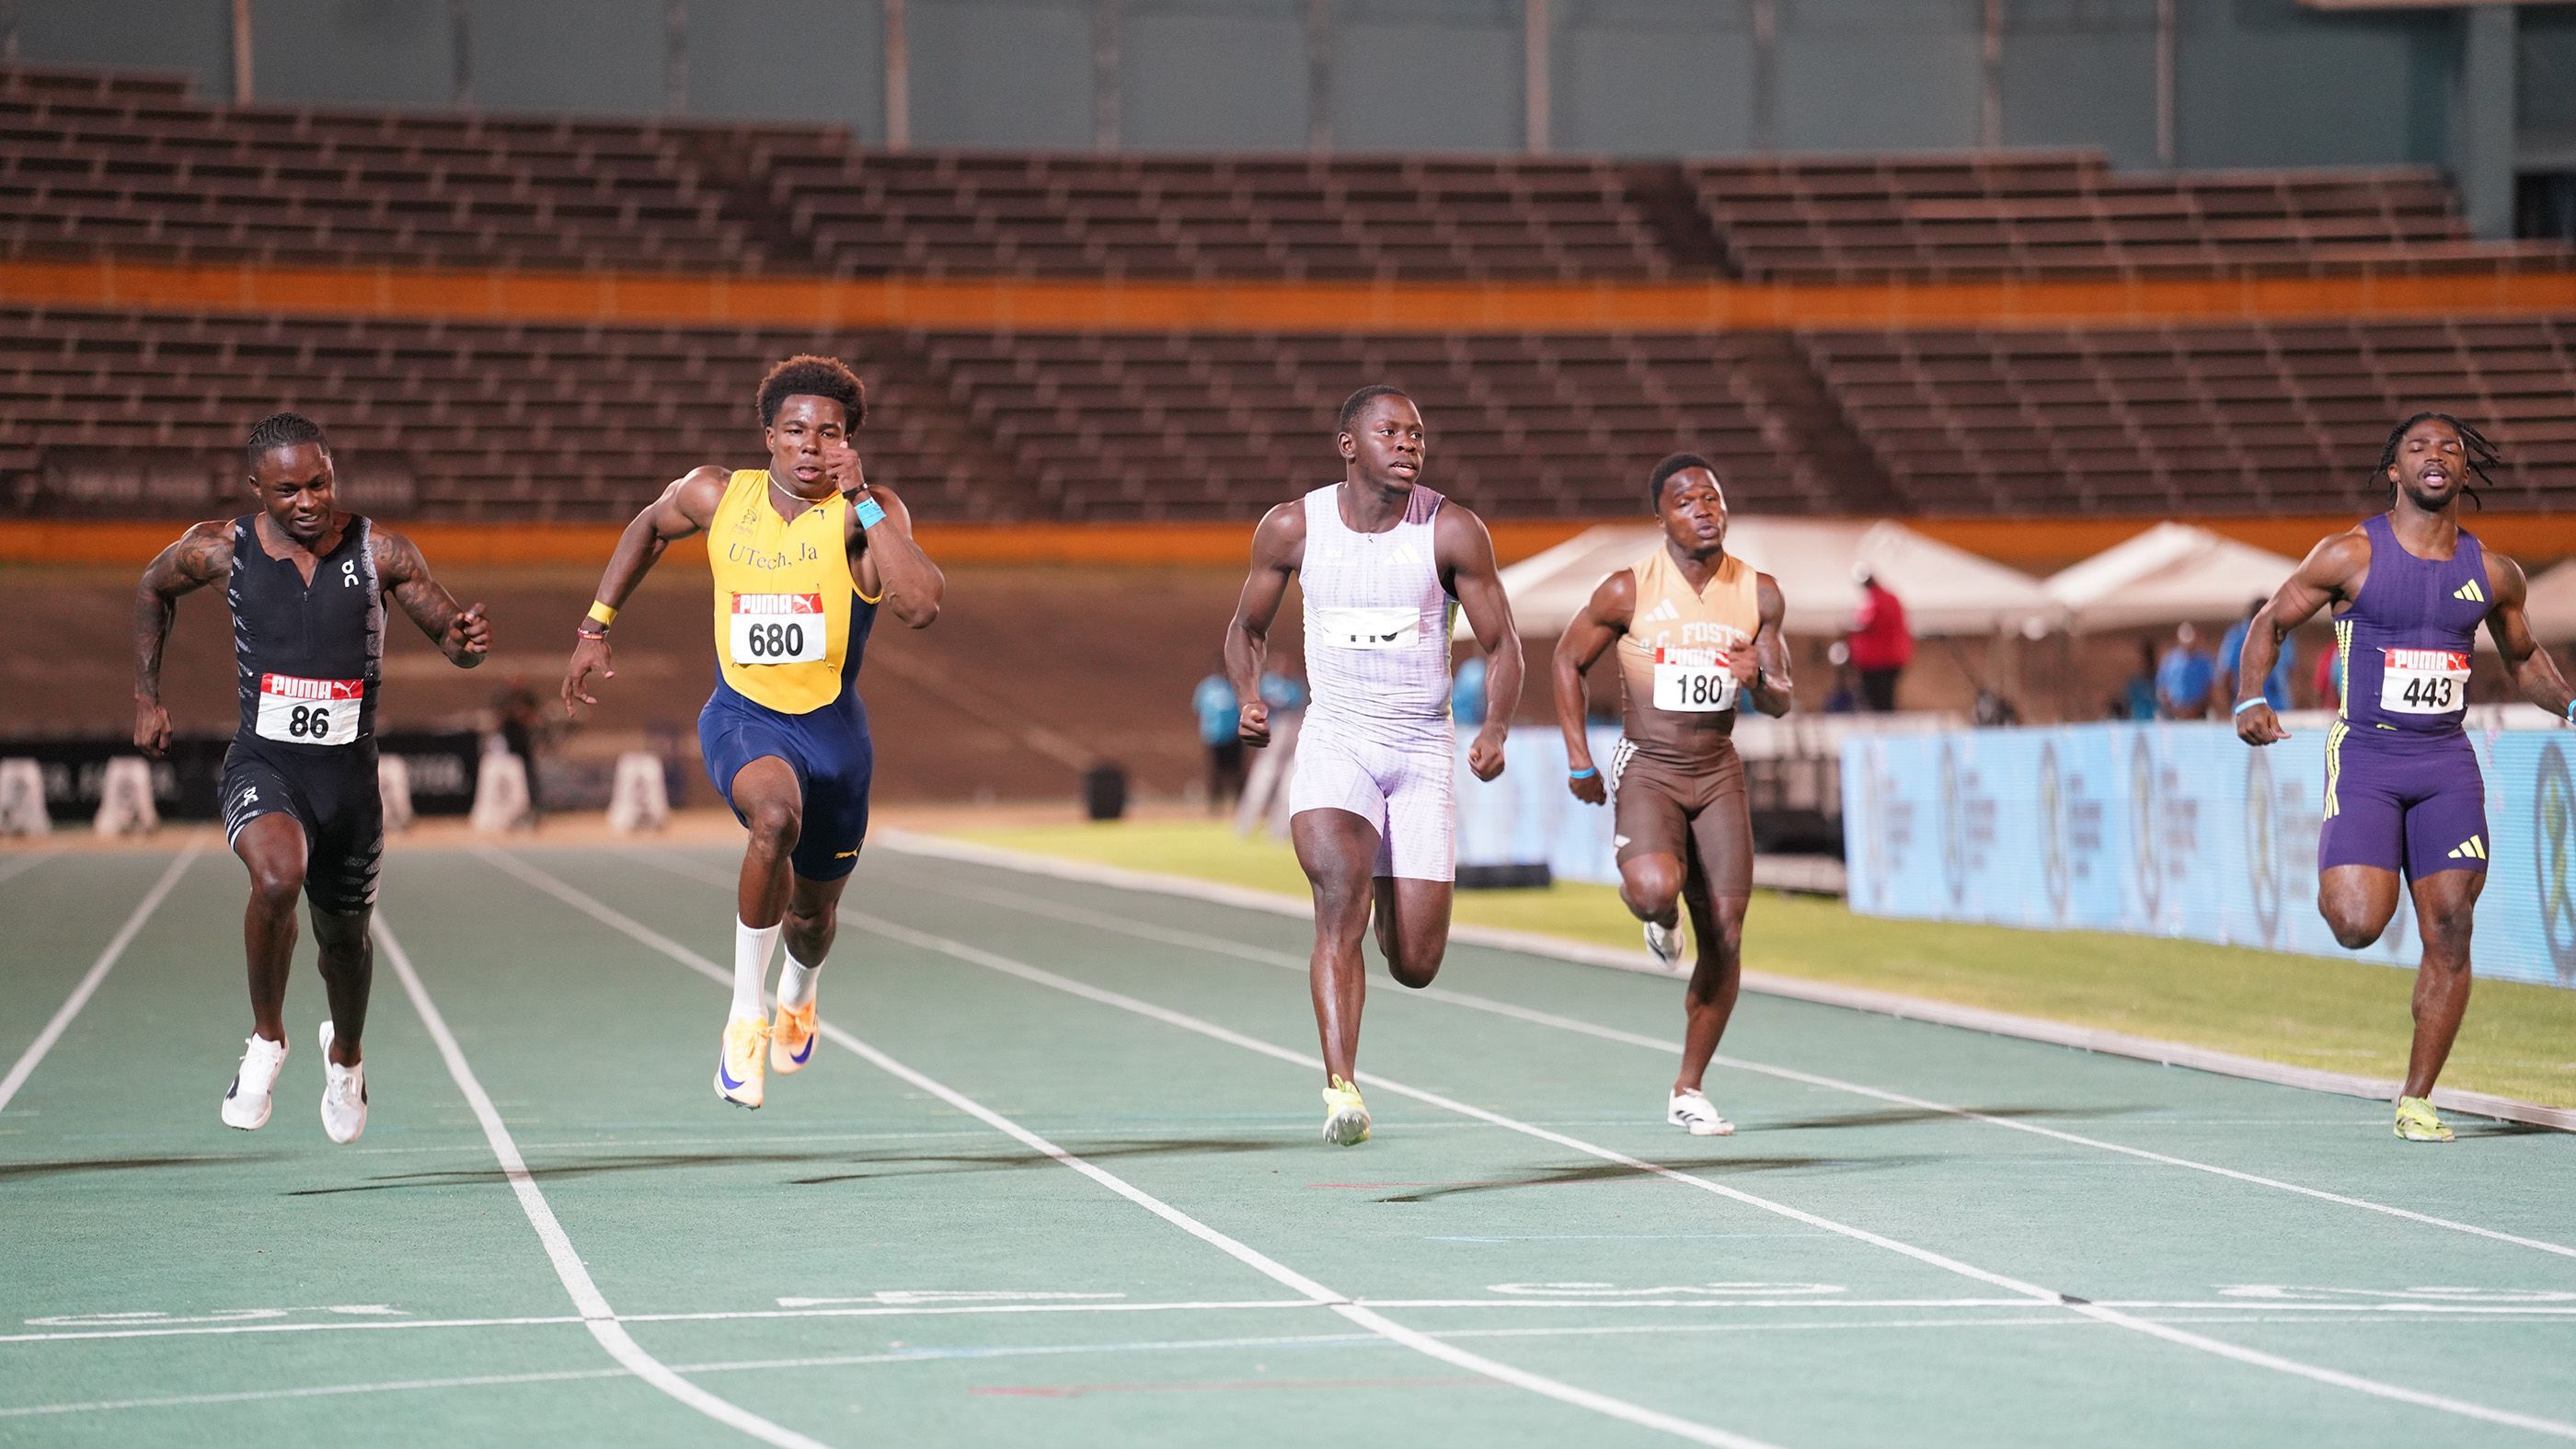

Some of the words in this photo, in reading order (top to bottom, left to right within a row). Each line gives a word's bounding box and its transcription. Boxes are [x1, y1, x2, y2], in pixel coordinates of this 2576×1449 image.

[729, 543, 792, 570] UTech,
[799, 542, 818, 561] Ja
[740, 594, 792, 615] PUMA
[749, 623, 804, 657] 680
[2395, 649, 2447, 671] PUMA
[271, 675, 332, 699] PUMA
[1677, 674, 1722, 705] 180
[2403, 677, 2452, 707] 443
[289, 705, 329, 739] 86
